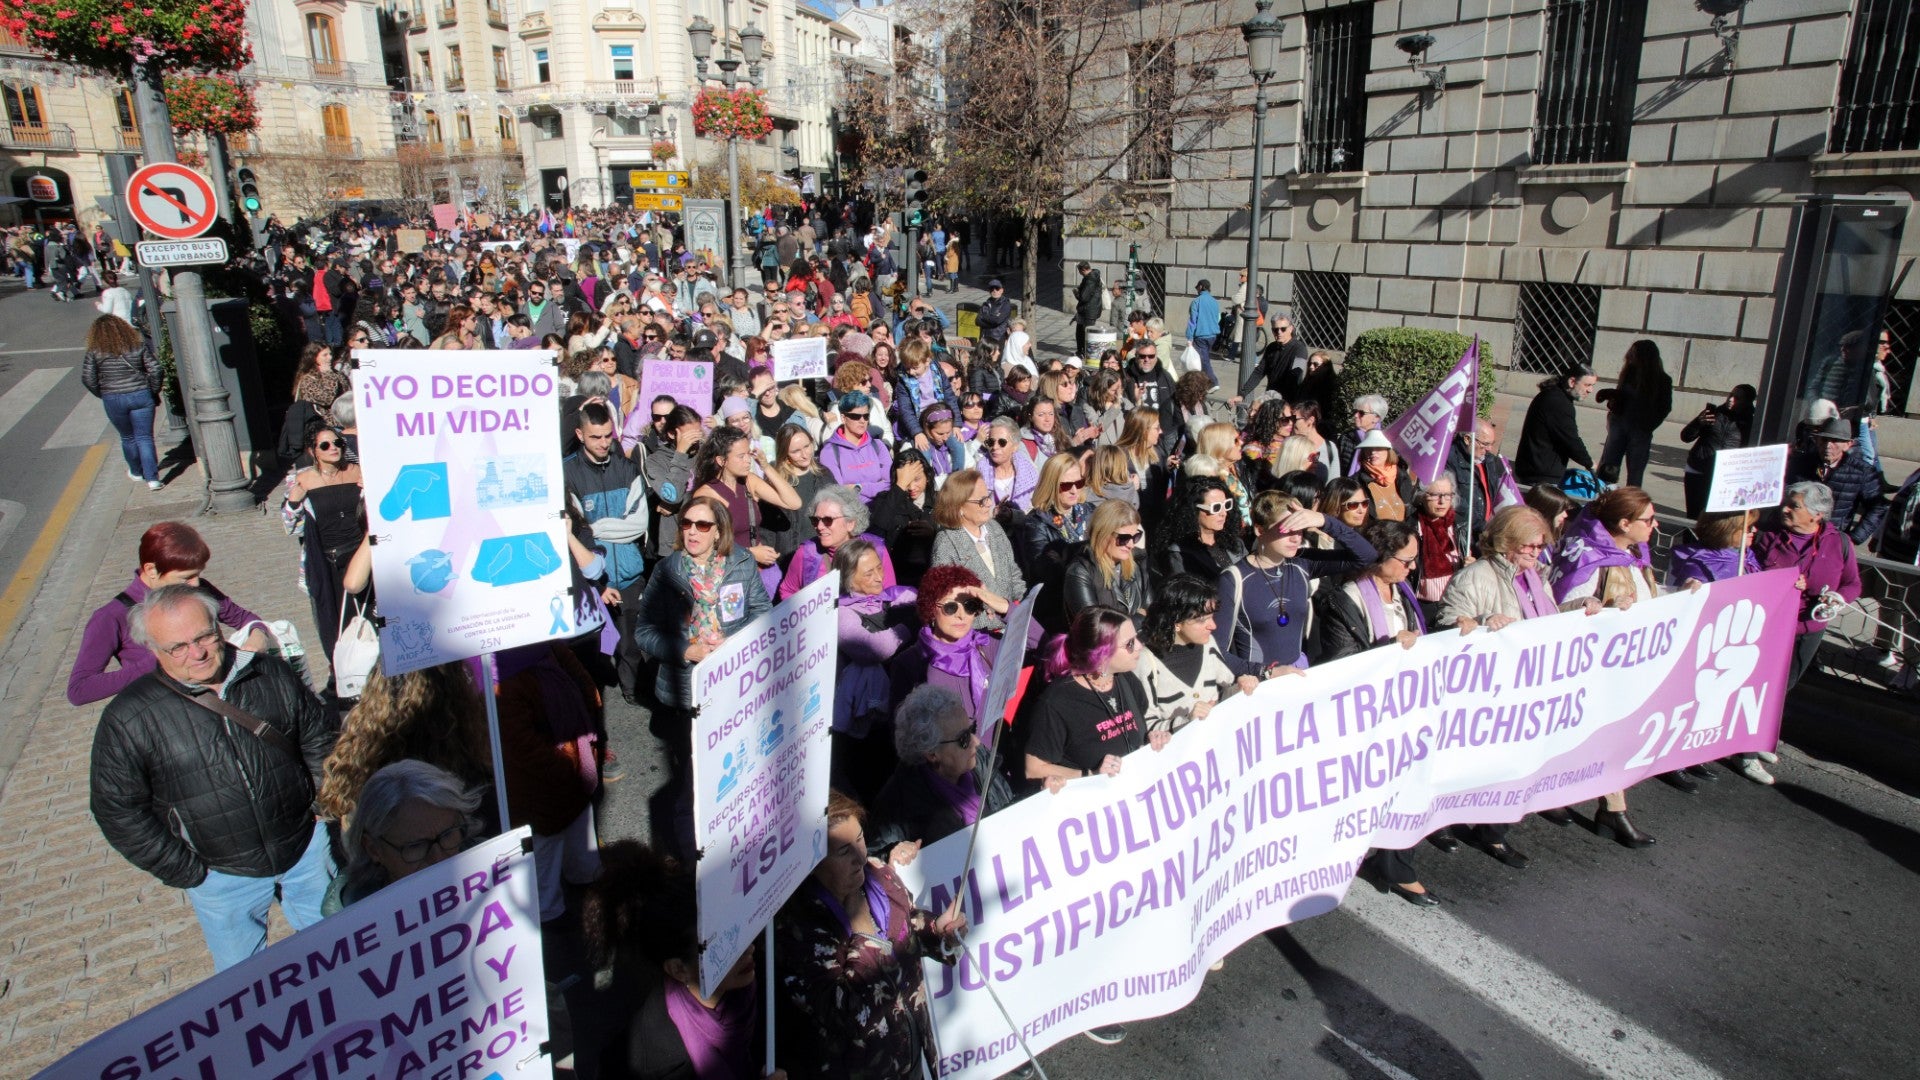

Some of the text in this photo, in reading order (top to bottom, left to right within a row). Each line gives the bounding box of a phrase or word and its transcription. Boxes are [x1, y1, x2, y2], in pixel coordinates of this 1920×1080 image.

[144, 244, 189, 253] EXCEPTO
[191, 242, 210, 250] BUS
[147, 252, 221, 262] TAXI URBANOS
[363, 373, 553, 408] ¡YO DECIDO
[396, 408, 530, 437] MI VIDA!
[650, 381, 711, 395] DONDE LAS
[464, 628, 487, 638] CONTRA
[480, 637, 501, 650] 25N
[703, 587, 832, 697] ¡MUJERES SORDAS
[739, 629, 807, 698] DOBLE
[708, 643, 829, 751] DISCRIMINACIÓN!
[1681, 726, 1724, 751] 2023
[708, 717, 825, 835] RECURSOS Y SERVICIOS
[728, 746, 808, 833] DE ATENCIÓN
[730, 768, 805, 853] A LA MUJER
[930, 618, 1677, 928] NI LA CULTURA, NI LA TRADICIÓN, NI LOS CELOS
[730, 803, 791, 873] ACCESIBLES
[793, 788, 806, 806] EN
[743, 814, 795, 897] LSE
[933, 850, 1186, 1000] JUSTIFICAN
[1192, 804, 1237, 884] LAS
[1243, 725, 1433, 834] VIOLENCIAS
[1205, 870, 1230, 913] UNA
[1233, 835, 1298, 888] MENOS!
[938, 1032, 1018, 1079] ESPACIO
[1022, 981, 1118, 1043] FEMINISMO
[1124, 953, 1197, 998] UNITARIO
[1206, 898, 1242, 947] GRANÁ
[1256, 861, 1353, 910] PLATAFORMA
[1379, 811, 1428, 831] ONTRA
[1434, 791, 1501, 812] VIOLENCIA
[1503, 789, 1523, 806] DE
[1558, 761, 1604, 788] GRANADA
[100, 857, 512, 1080] SENTIRME LIBRE
[245, 900, 514, 1068] MI VIDA
[485, 944, 517, 983] Y
[366, 987, 525, 1080] ARME
